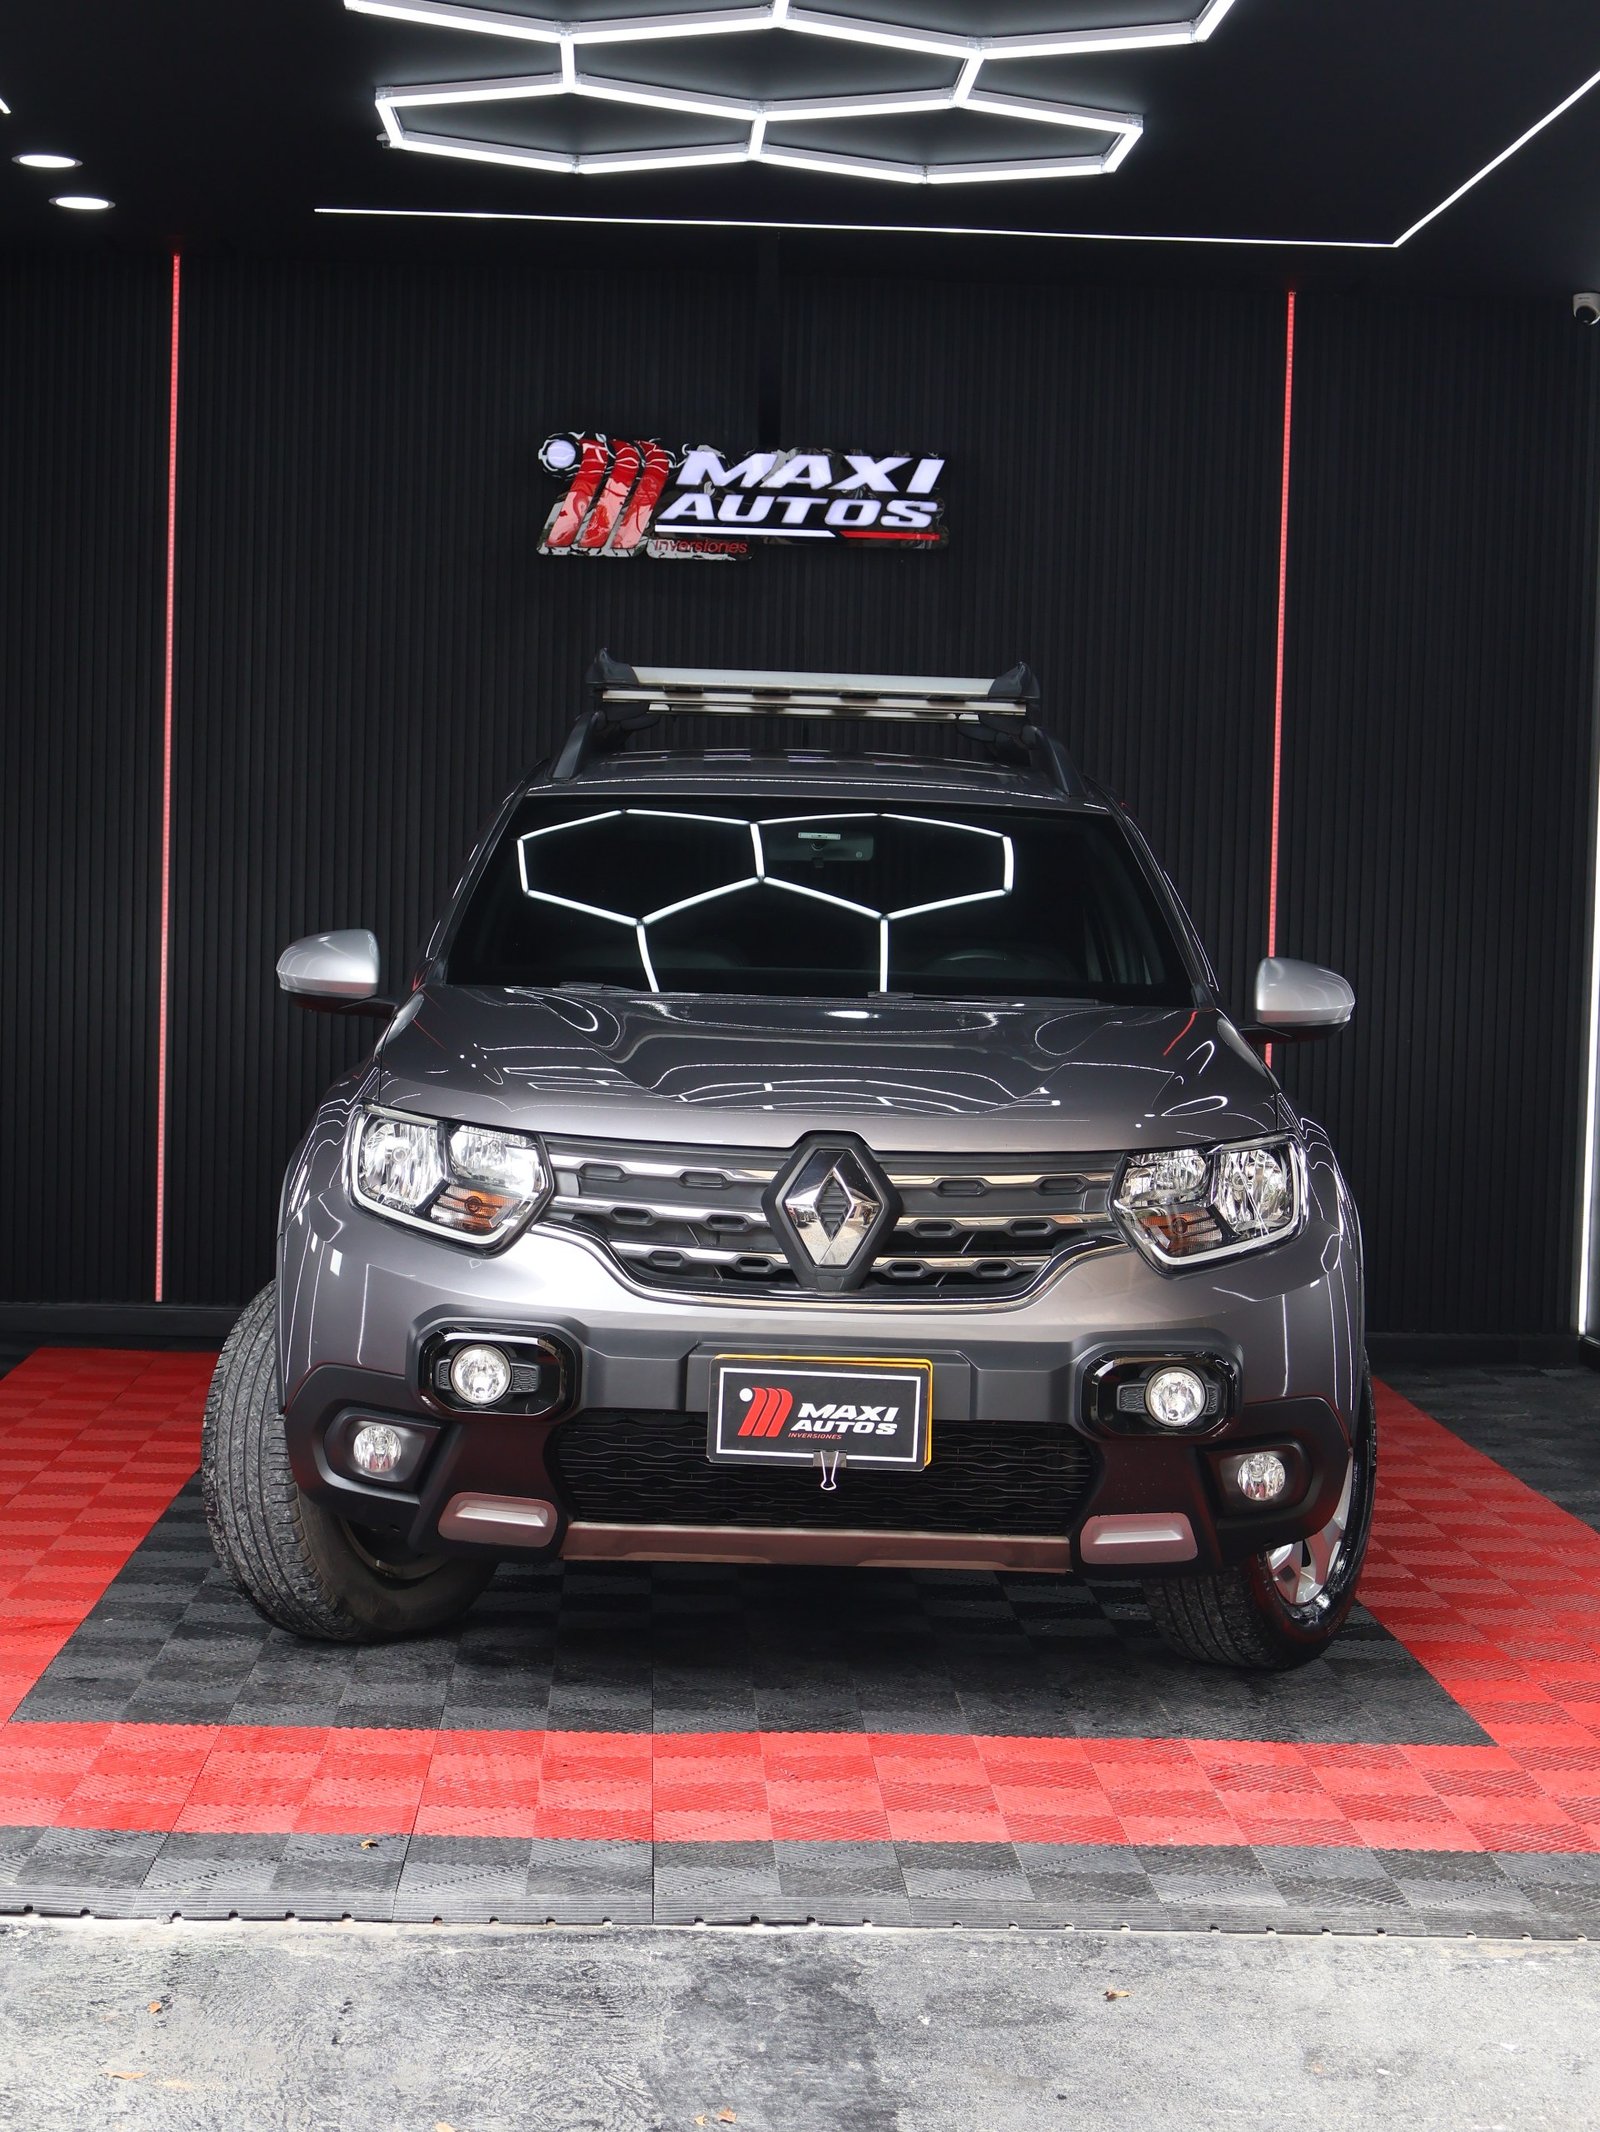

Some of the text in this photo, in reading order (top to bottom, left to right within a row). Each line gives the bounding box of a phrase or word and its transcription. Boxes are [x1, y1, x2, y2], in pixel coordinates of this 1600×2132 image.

[676, 450, 945, 493] MAXI
[659, 493, 939, 527] AUTOS
[798, 1403, 899, 1421] MAXI
[787, 1432, 843, 1440] INVERSIONES
[791, 1419, 898, 1435] AUTOS
